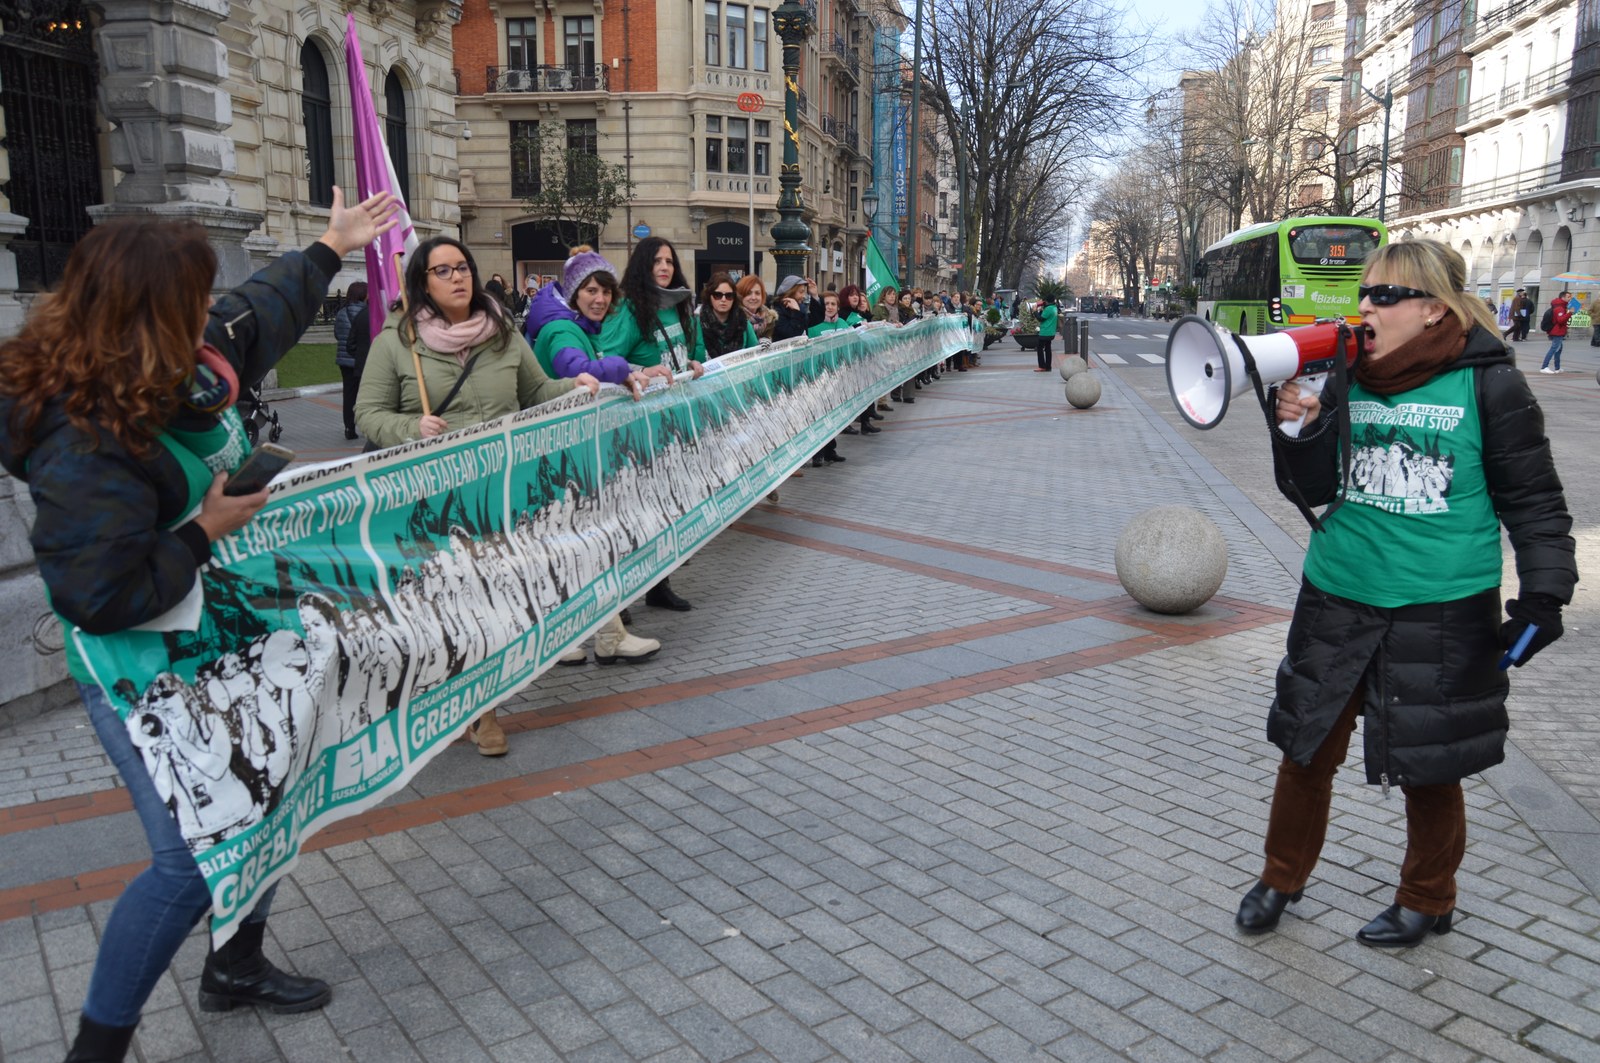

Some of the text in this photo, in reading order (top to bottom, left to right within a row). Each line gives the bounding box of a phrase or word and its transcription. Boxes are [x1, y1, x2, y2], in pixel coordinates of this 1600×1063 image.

[895, 163, 905, 194] INOX
[716, 236, 744, 246] TOUS
[1329, 245, 1346, 257] 3151
[1316, 294, 1352, 305] Bizkaia
[1400, 404, 1413, 412] DE
[1416, 405, 1461, 417] BIZKAIA
[1428, 416, 1459, 432] STOP
[369, 439, 505, 515] PREKARIETATEARI STOP
[316, 485, 362, 534] STOP
[410, 669, 500, 751] GREBAN!!
[499, 630, 537, 684] ELA
[411, 685, 449, 716] BIZKAIKO
[212, 718, 400, 920] GREBAN!! ELA
[199, 822, 272, 880] BIZKAIKO
